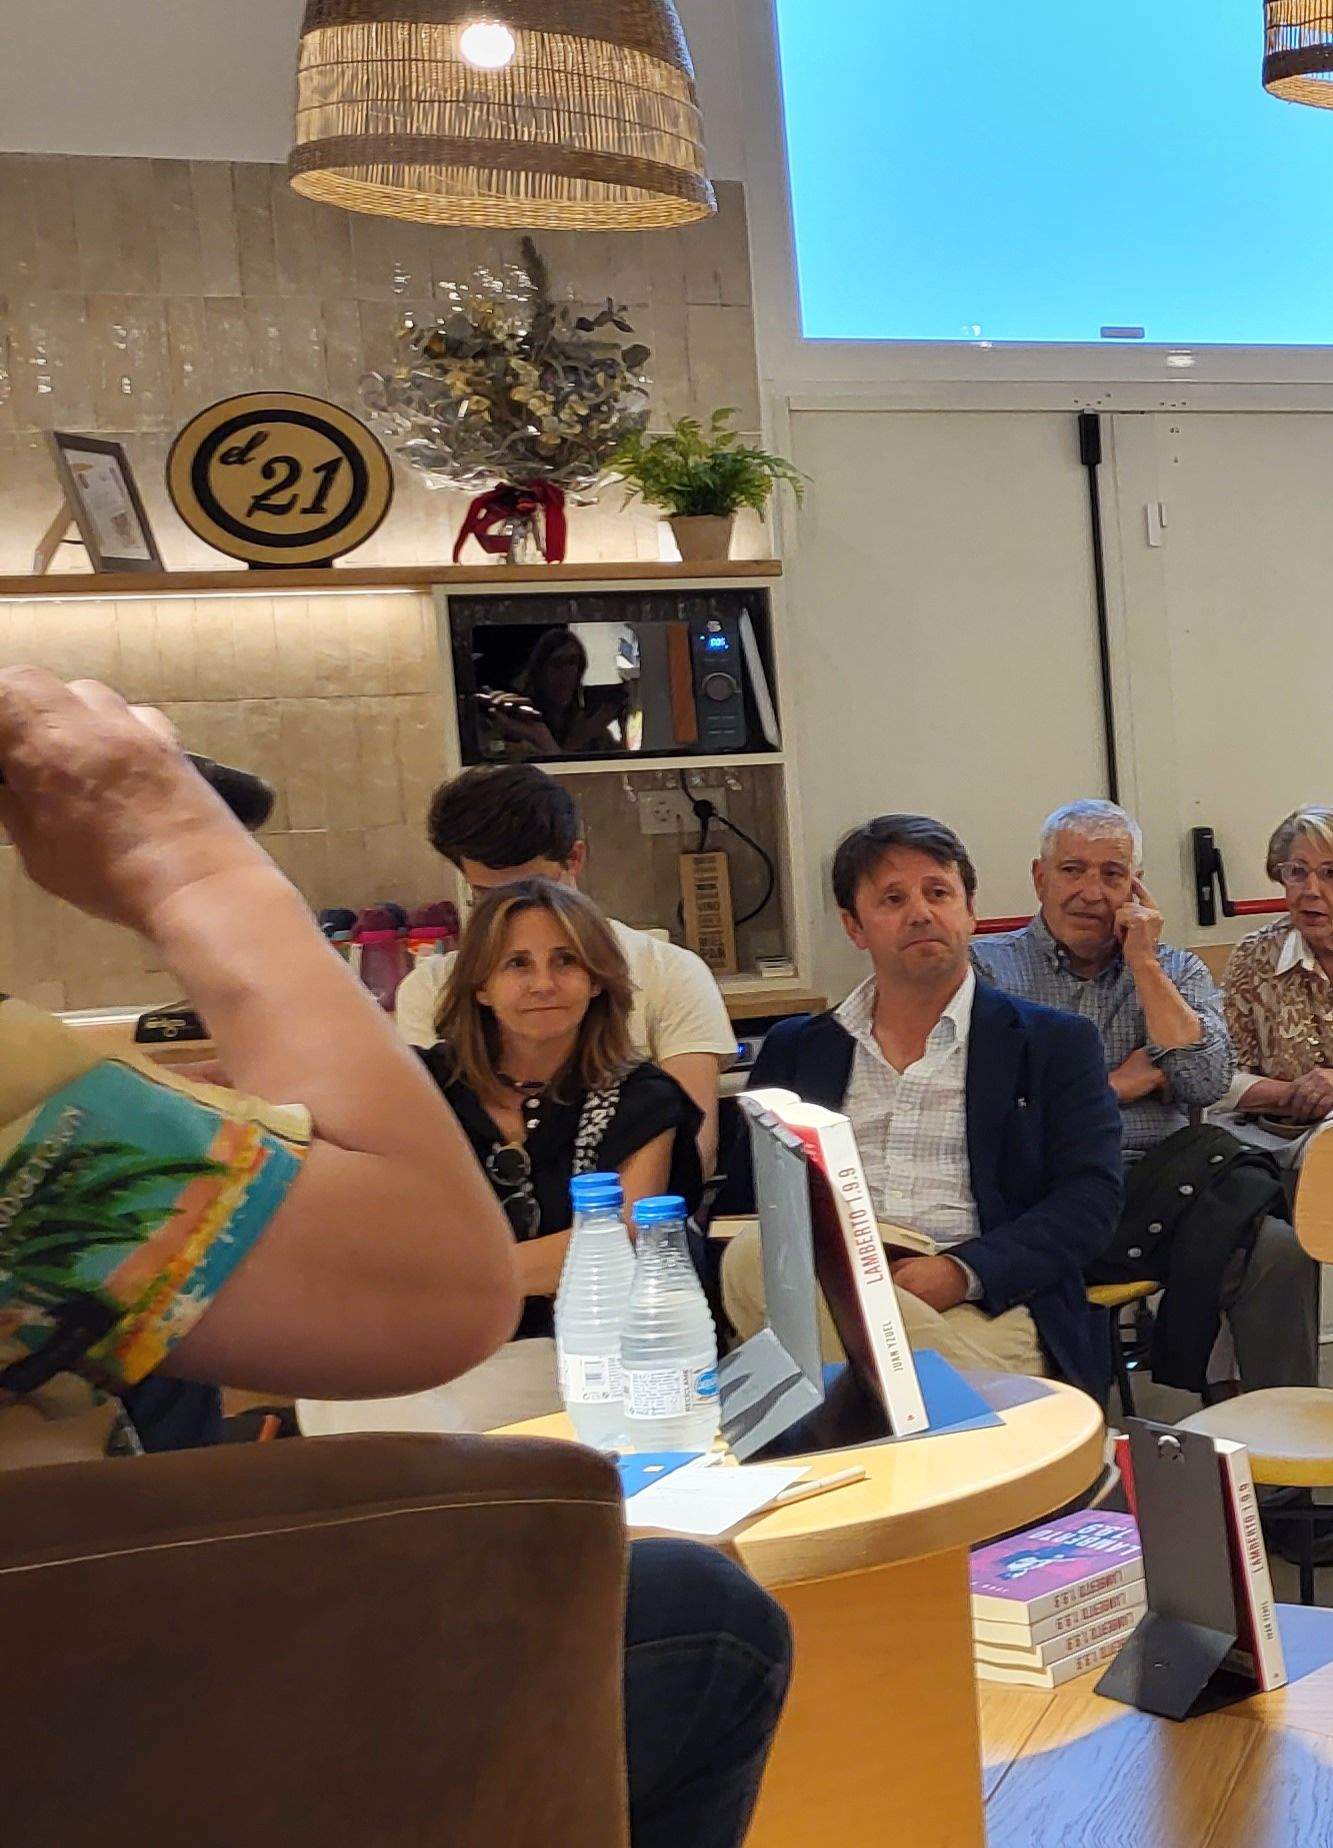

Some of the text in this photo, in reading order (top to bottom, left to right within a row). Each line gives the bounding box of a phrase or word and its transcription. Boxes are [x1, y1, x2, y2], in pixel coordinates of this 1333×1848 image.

[246, 455, 344, 517] 21
[838, 1167, 884, 1284] LAMBERTO 1.9.9
[882, 1320, 904, 1372] JUAN YZUEL
[1244, 1514, 1263, 1574] LAMBERTO
